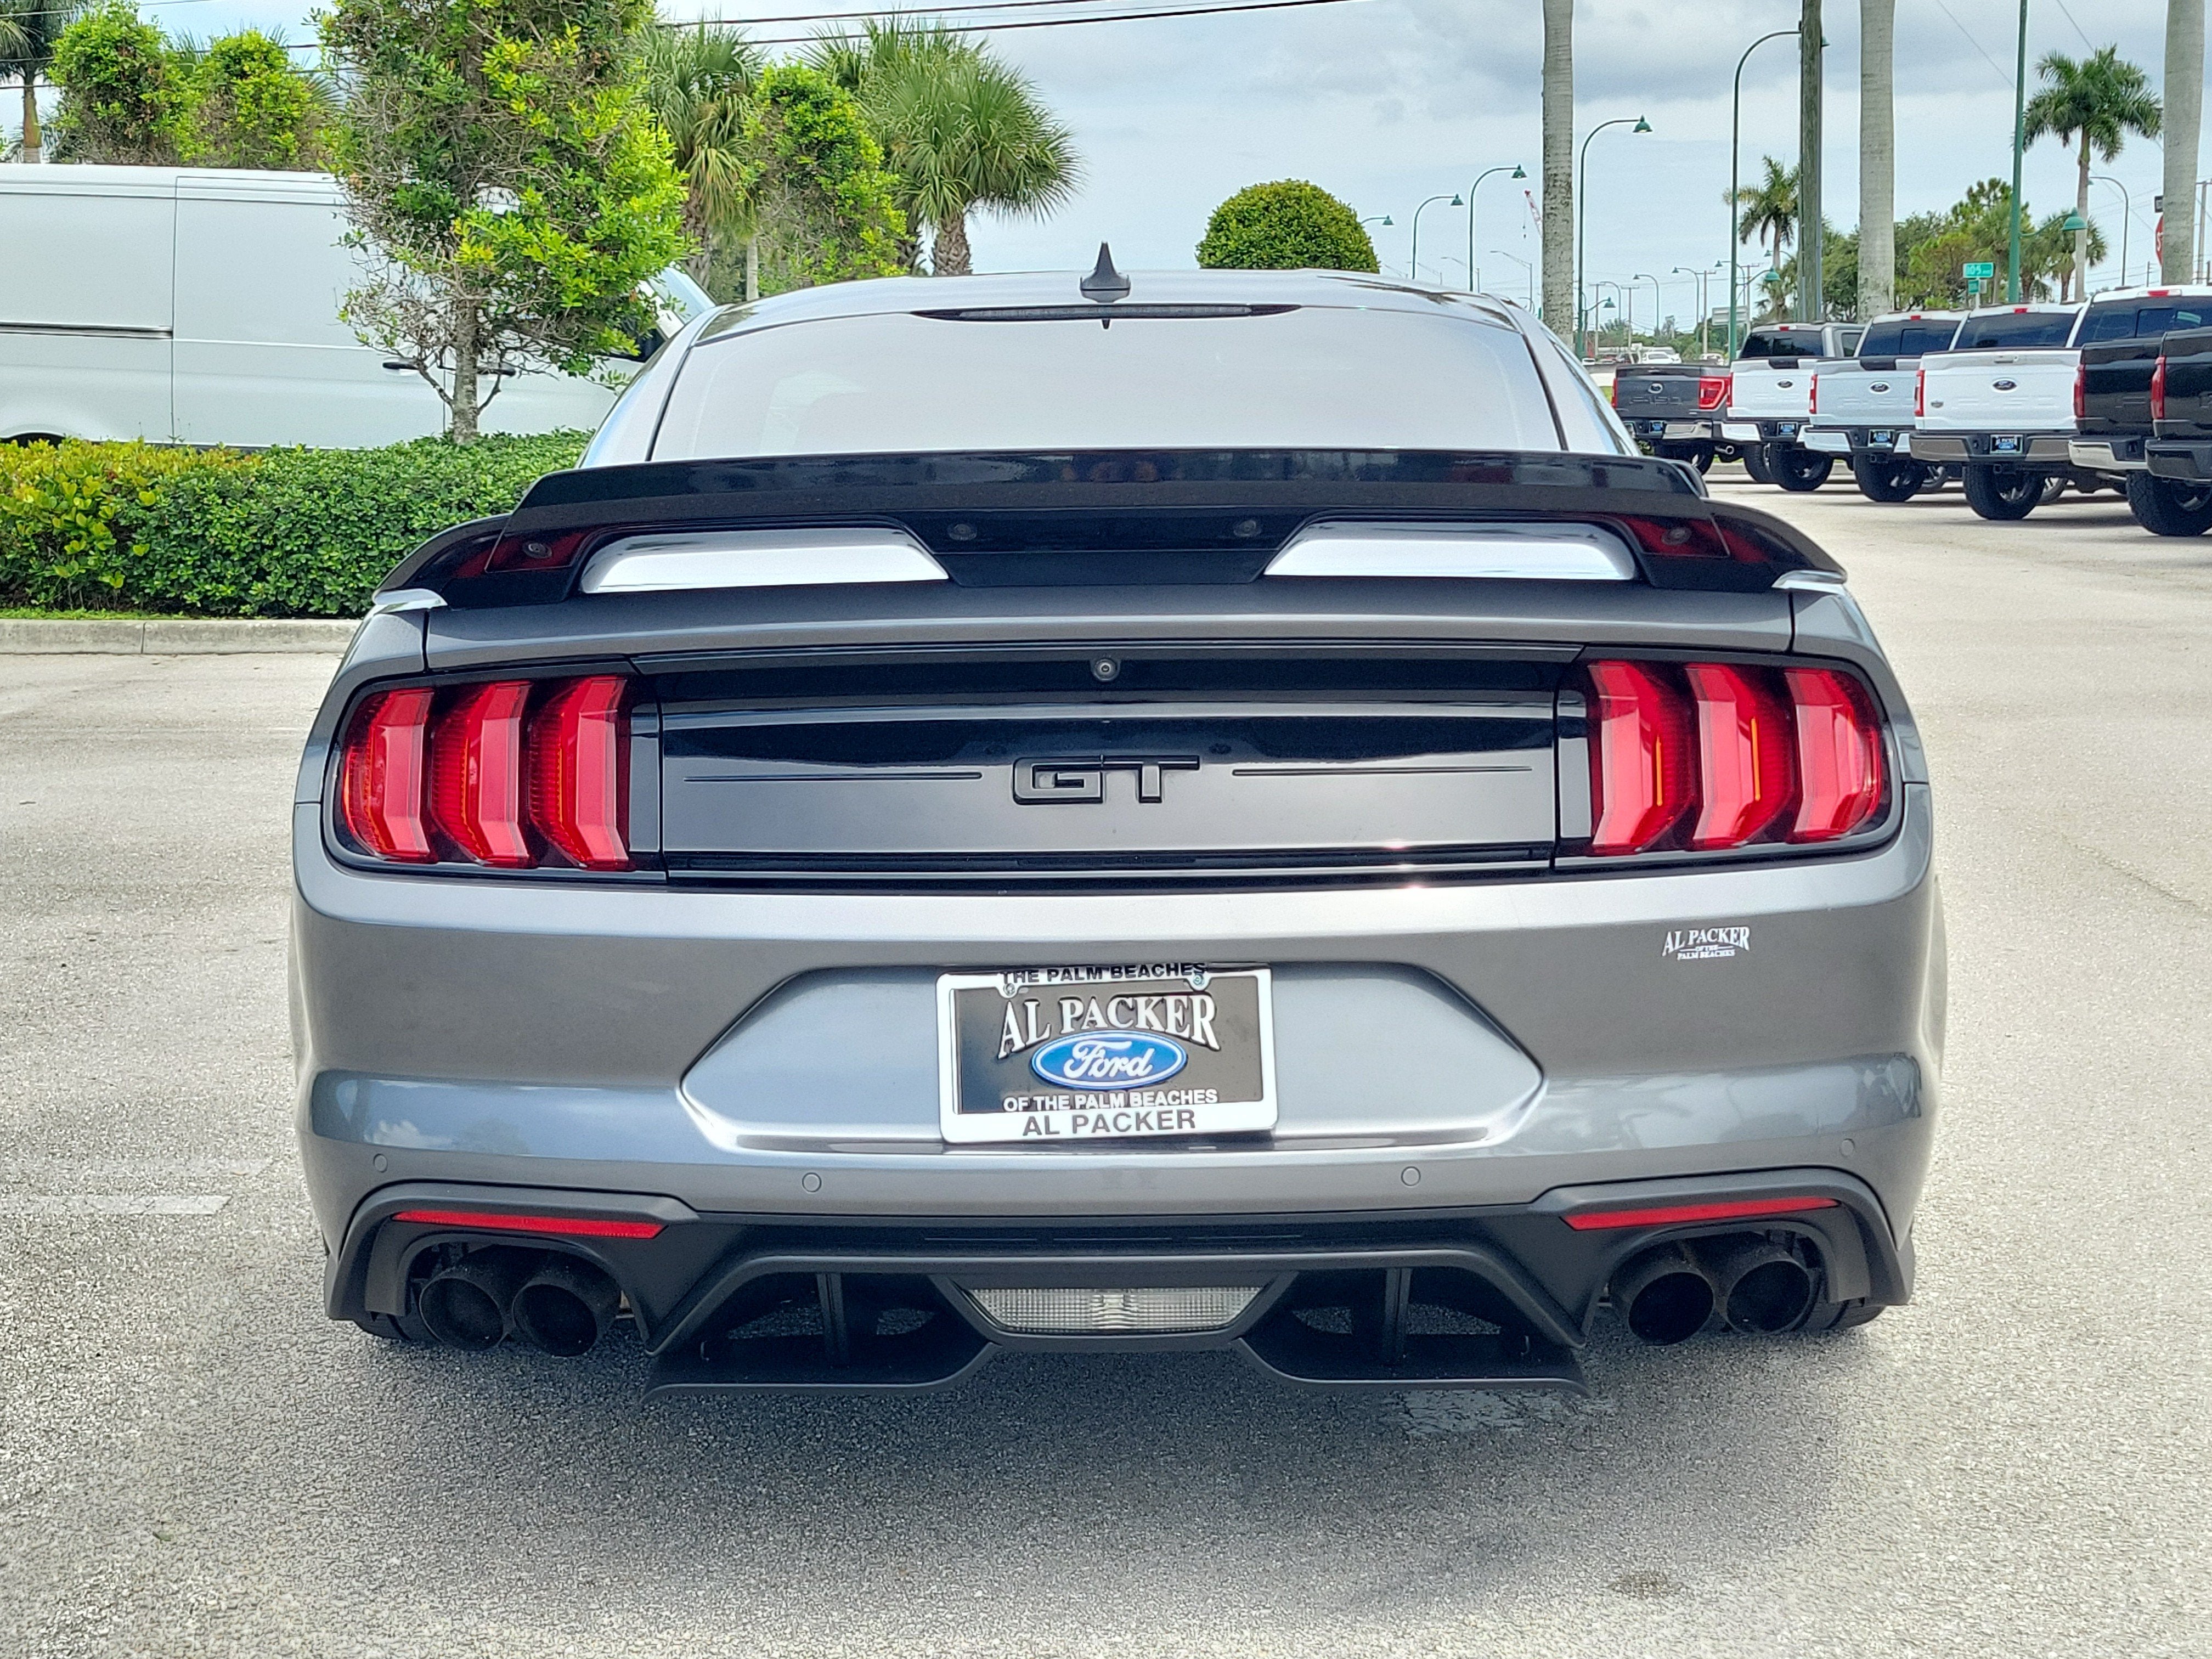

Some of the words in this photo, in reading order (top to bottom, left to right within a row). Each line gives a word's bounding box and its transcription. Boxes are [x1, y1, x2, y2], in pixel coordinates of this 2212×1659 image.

[1013, 755, 1200, 805] GT
[1662, 931, 1686, 956] AL
[1687, 926, 1750, 951] PACKER
[1000, 970, 1040, 985] THE
[1047, 966, 1103, 982] PALM
[1110, 962, 1206, 979] BEACHES
[998, 1000, 1052, 1060] AL
[1059, 991, 1221, 1052] PACKER
[1063, 1040, 1156, 1079] Ford
[1003, 1097, 1029, 1112] OF
[1032, 1095, 1070, 1111] THE
[1074, 1093, 1124, 1109] PALM
[1129, 1088, 1218, 1107] BEACHES
[1023, 1114, 1060, 1136] AL
[1072, 1108, 1196, 1134] PACKER
